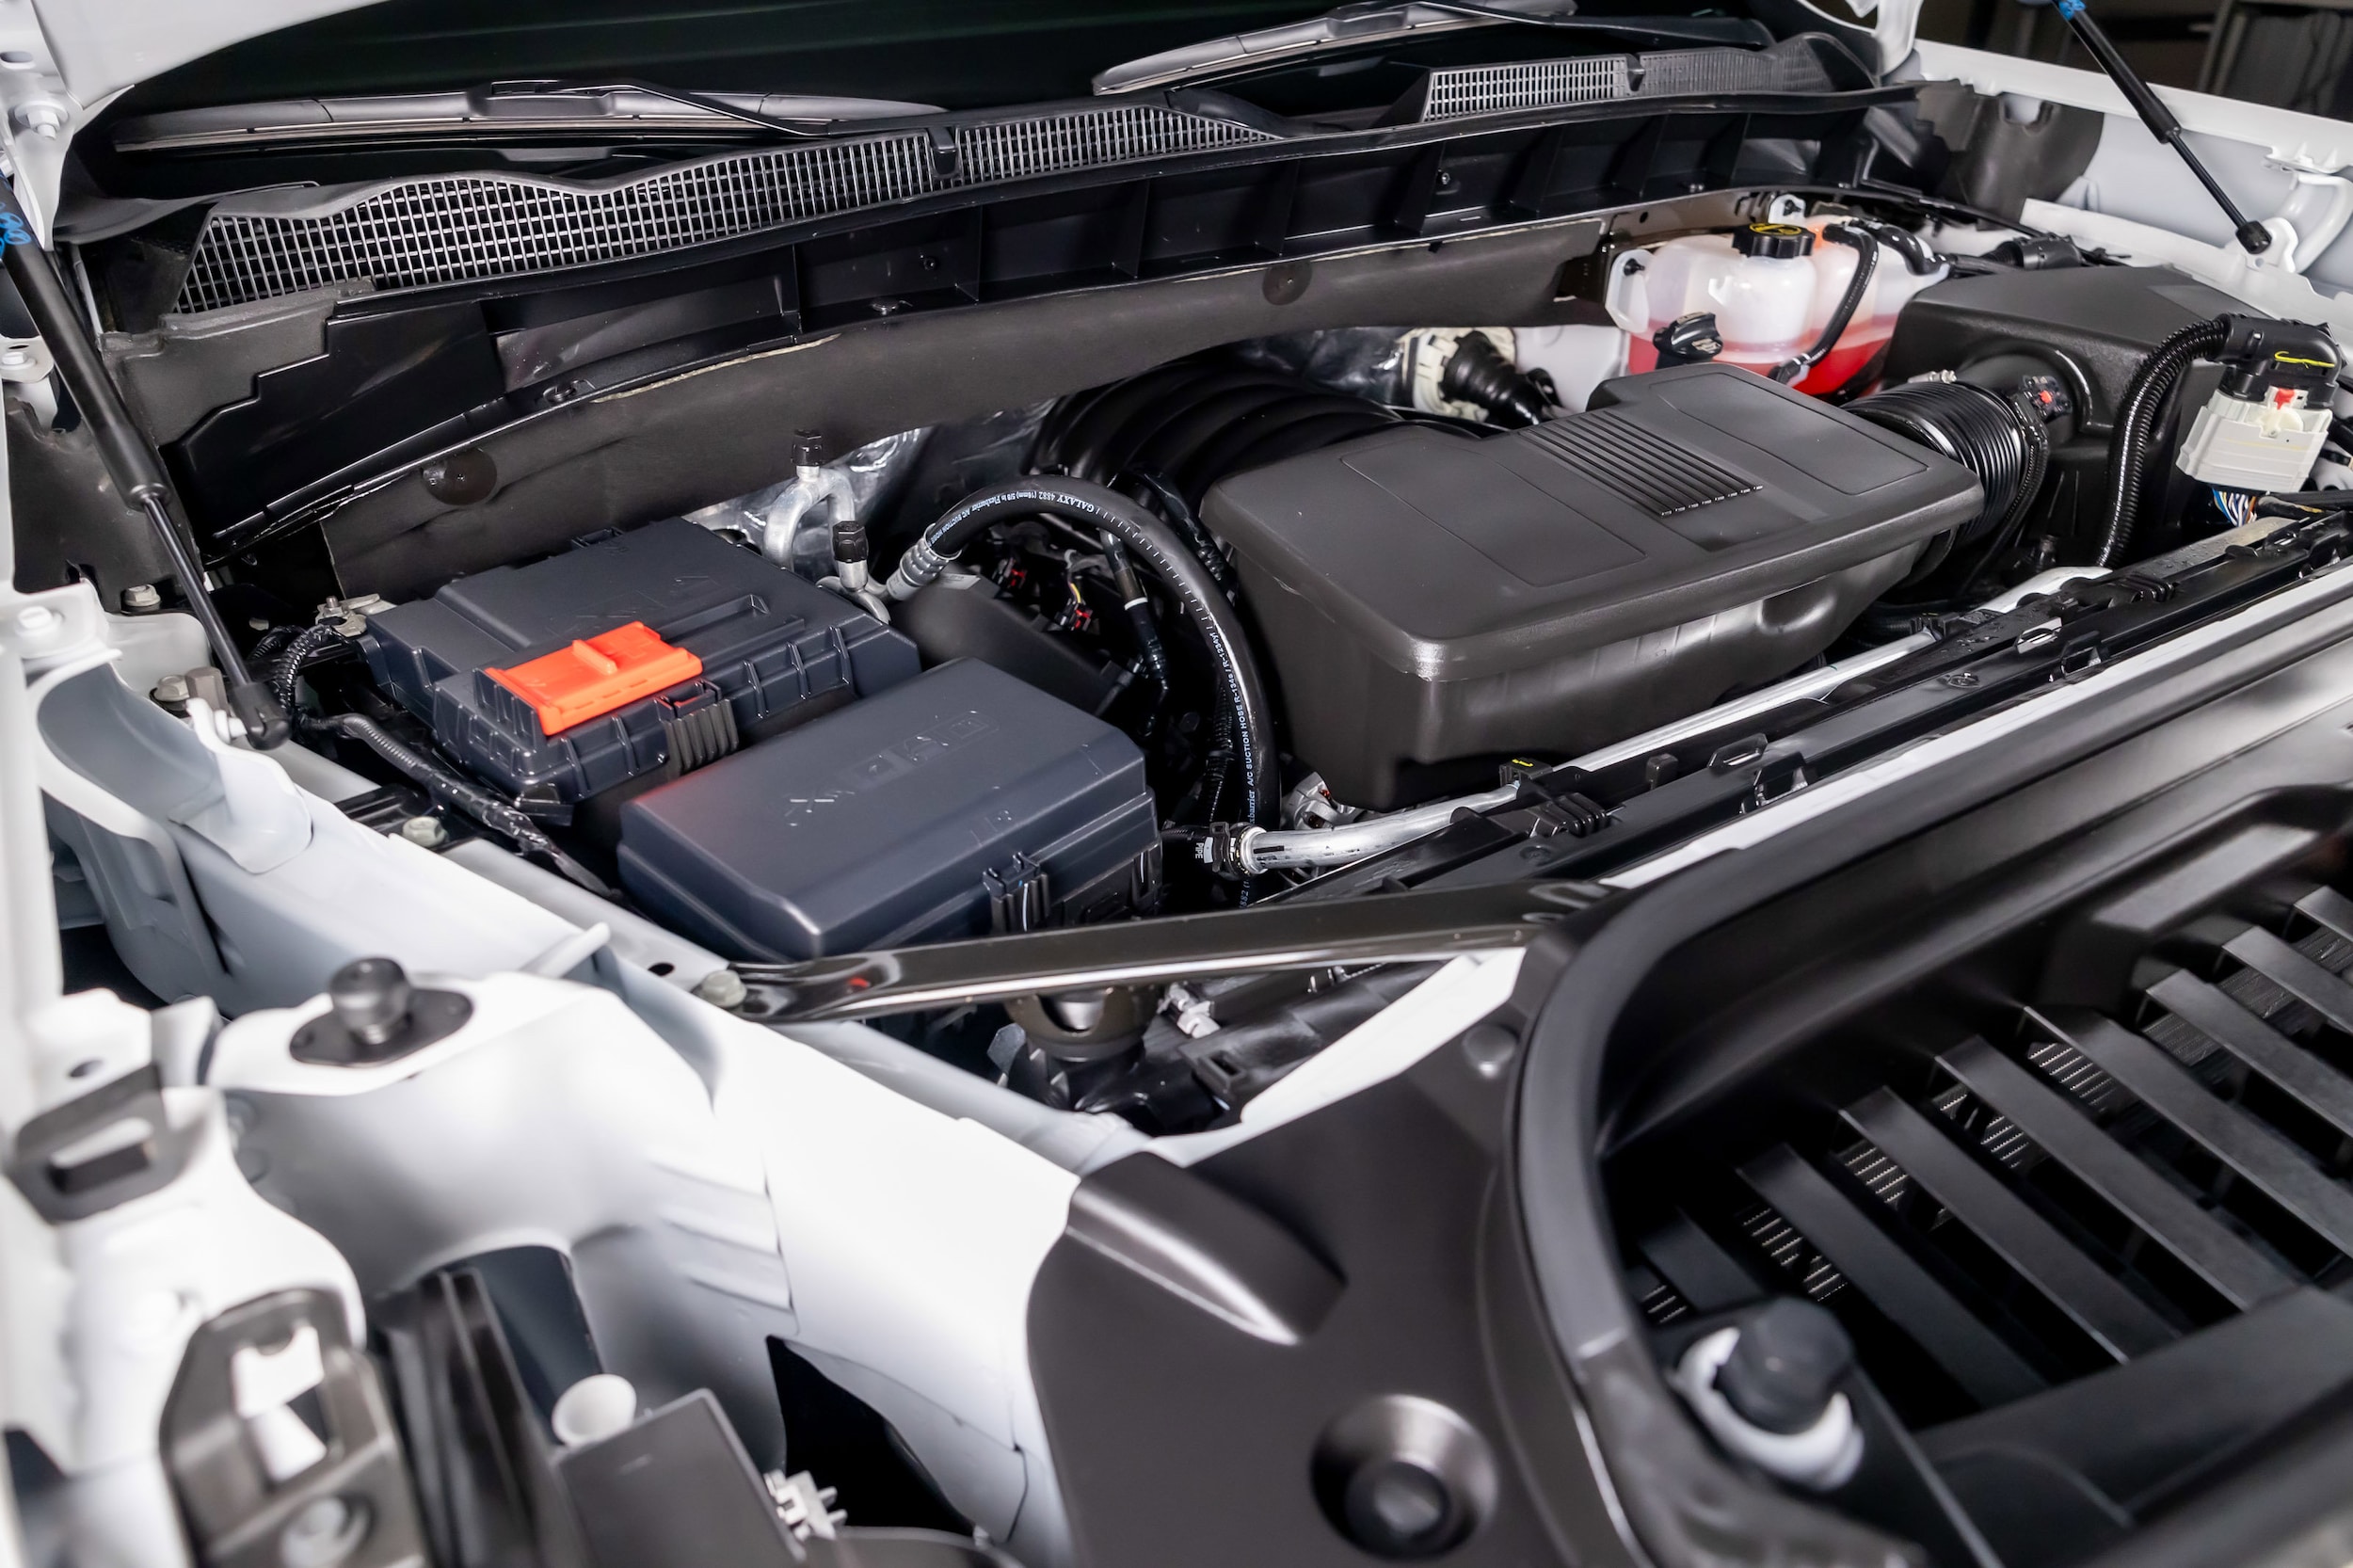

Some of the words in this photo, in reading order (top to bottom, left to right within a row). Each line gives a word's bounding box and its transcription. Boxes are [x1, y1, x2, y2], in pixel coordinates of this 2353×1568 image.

[971, 494, 1000, 512] Flexbarrier
[1038, 491, 1055, 502] 4882
[1056, 494, 1095, 513] GALAXY
[961, 507, 970, 519] A/C
[941, 513, 962, 533] SUCTION
[1209, 632, 1229, 668] R-1234yf
[1236, 704, 1247, 729] HOSE
[1242, 730, 1253, 770] SUCTION
[1247, 790, 1256, 824] xbarrier
[1195, 842, 1205, 859] PIPE
[1239, 889, 1249, 908] 882
